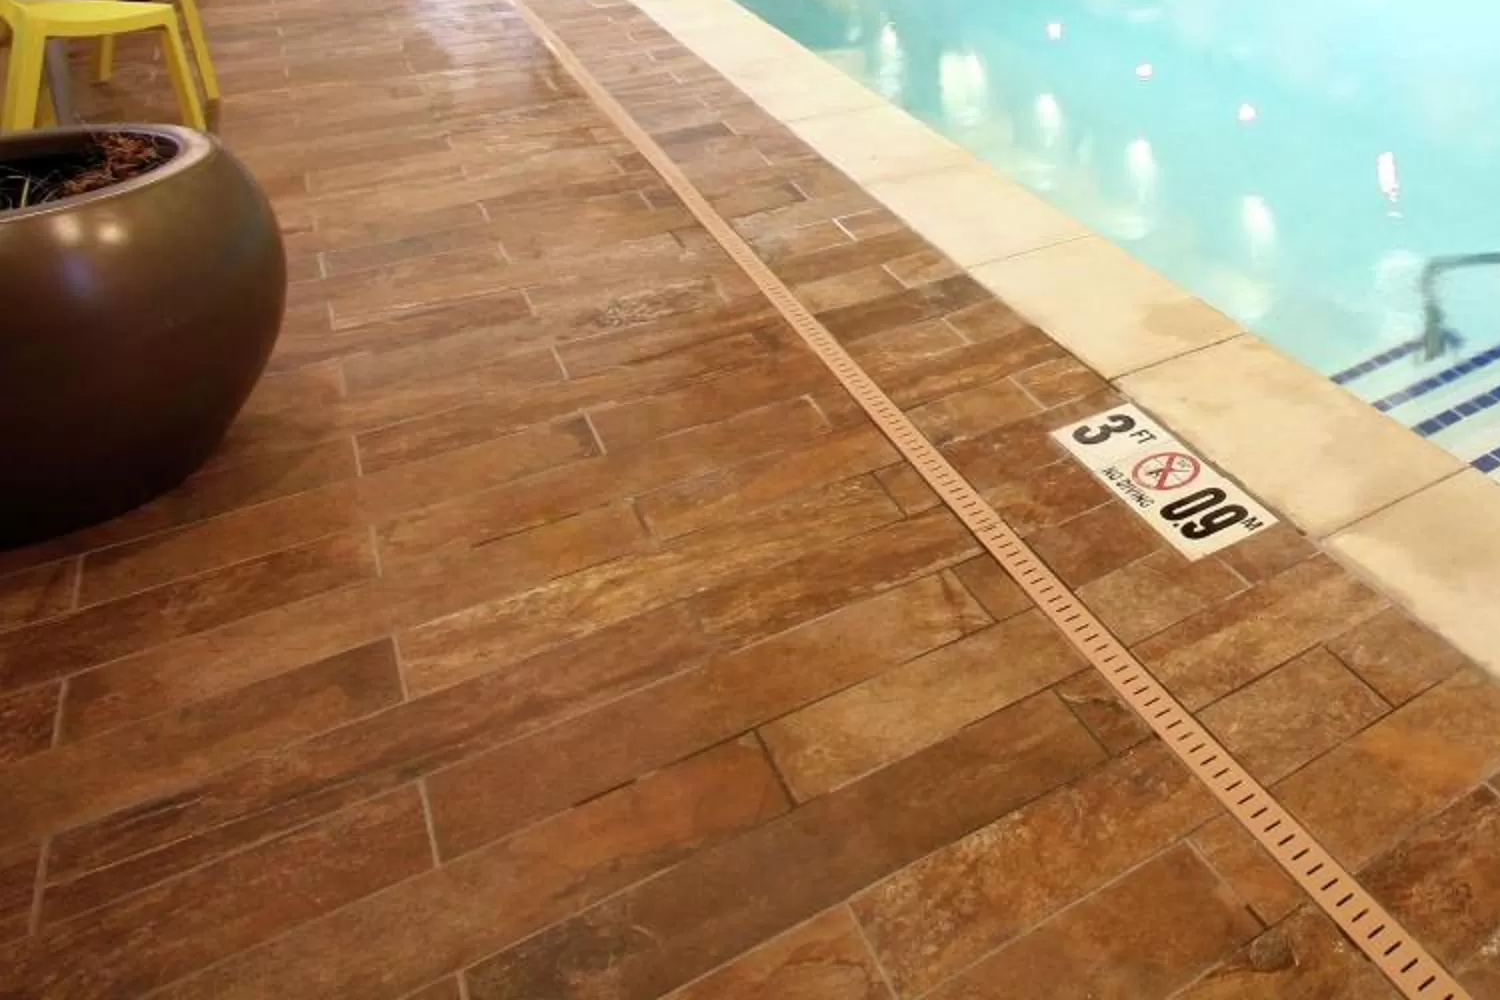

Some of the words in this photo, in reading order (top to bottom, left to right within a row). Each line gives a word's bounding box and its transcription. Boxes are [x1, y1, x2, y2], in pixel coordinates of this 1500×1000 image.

[1072, 413, 1136, 445] 3
[1130, 428, 1158, 444] FT
[1115, 478, 1155, 508] DIVING
